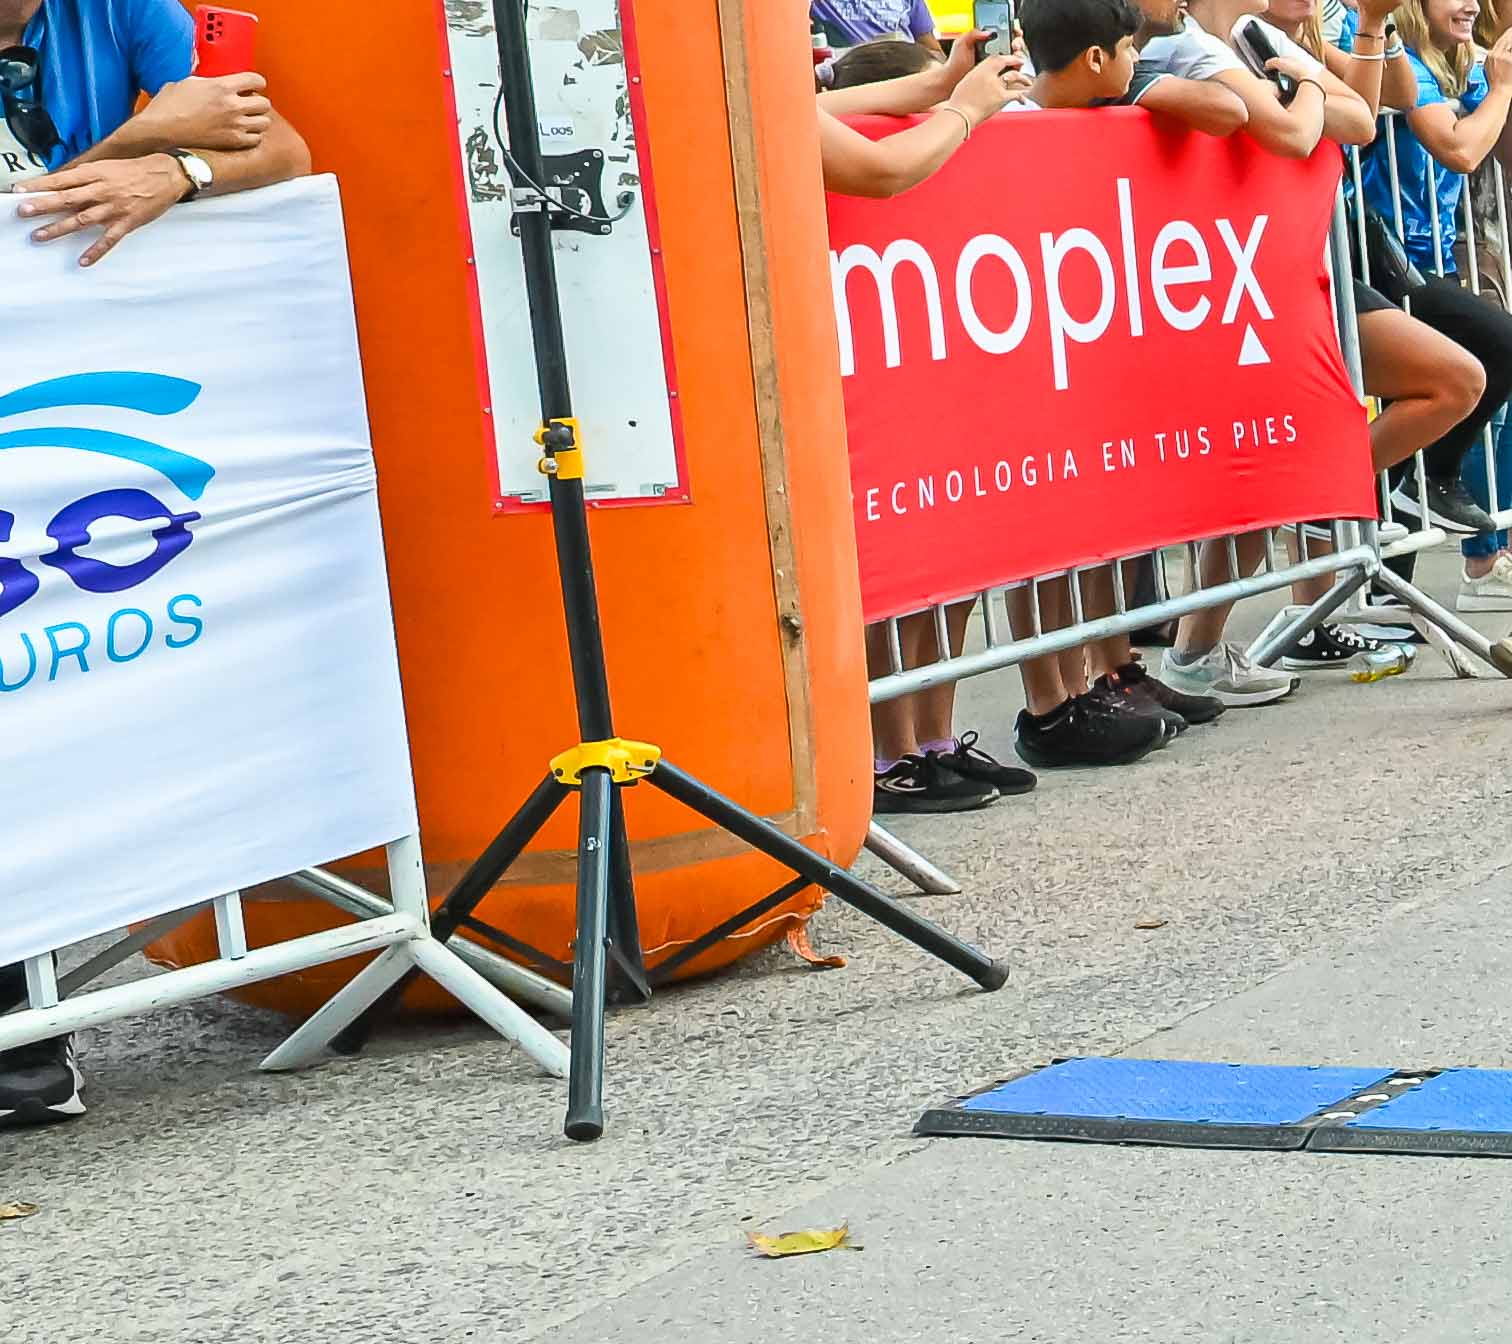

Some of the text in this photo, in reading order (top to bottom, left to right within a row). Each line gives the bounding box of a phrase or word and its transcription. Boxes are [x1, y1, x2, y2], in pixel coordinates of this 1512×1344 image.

[829, 177, 1275, 391] moplex
[850, 414, 1298, 522] ECNOLOGIA EN TUS PIES
